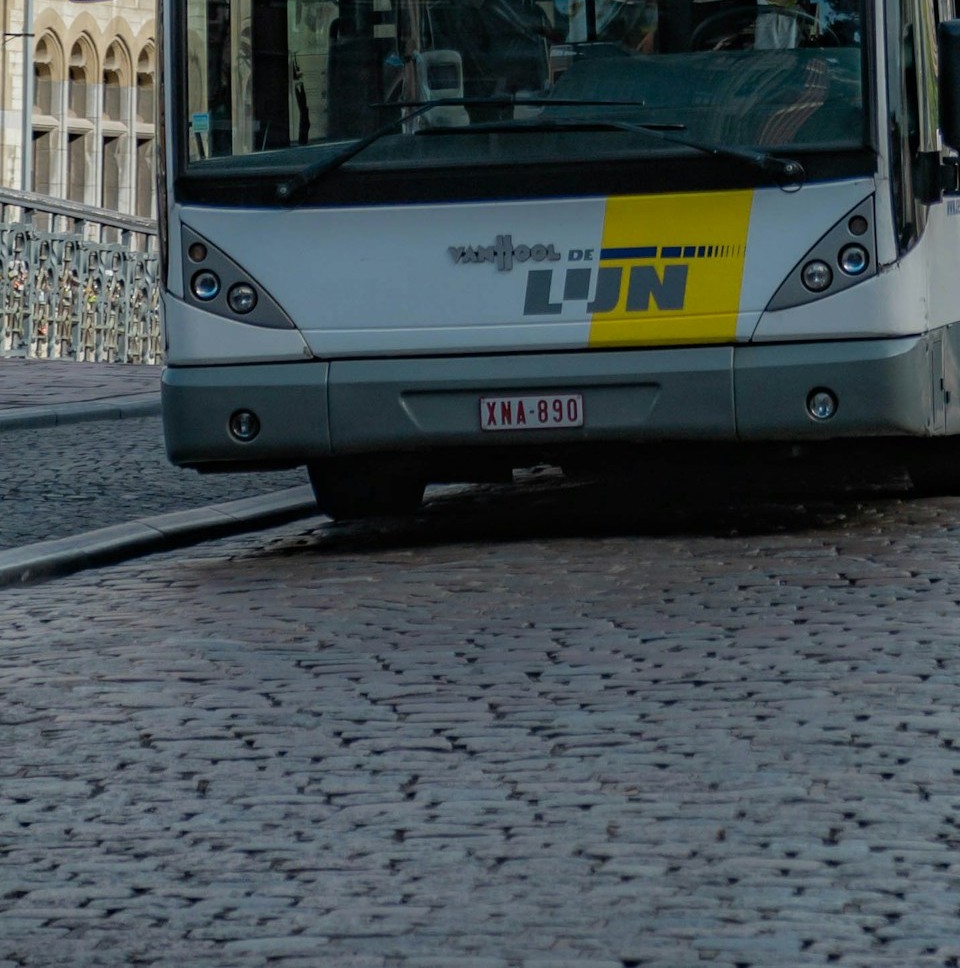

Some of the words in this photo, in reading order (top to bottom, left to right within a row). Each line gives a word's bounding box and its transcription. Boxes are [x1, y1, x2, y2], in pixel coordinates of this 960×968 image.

[568, 248, 594, 262] DE
[523, 264, 689, 316] LIJN
[486, 398, 579, 427] XNA-890
